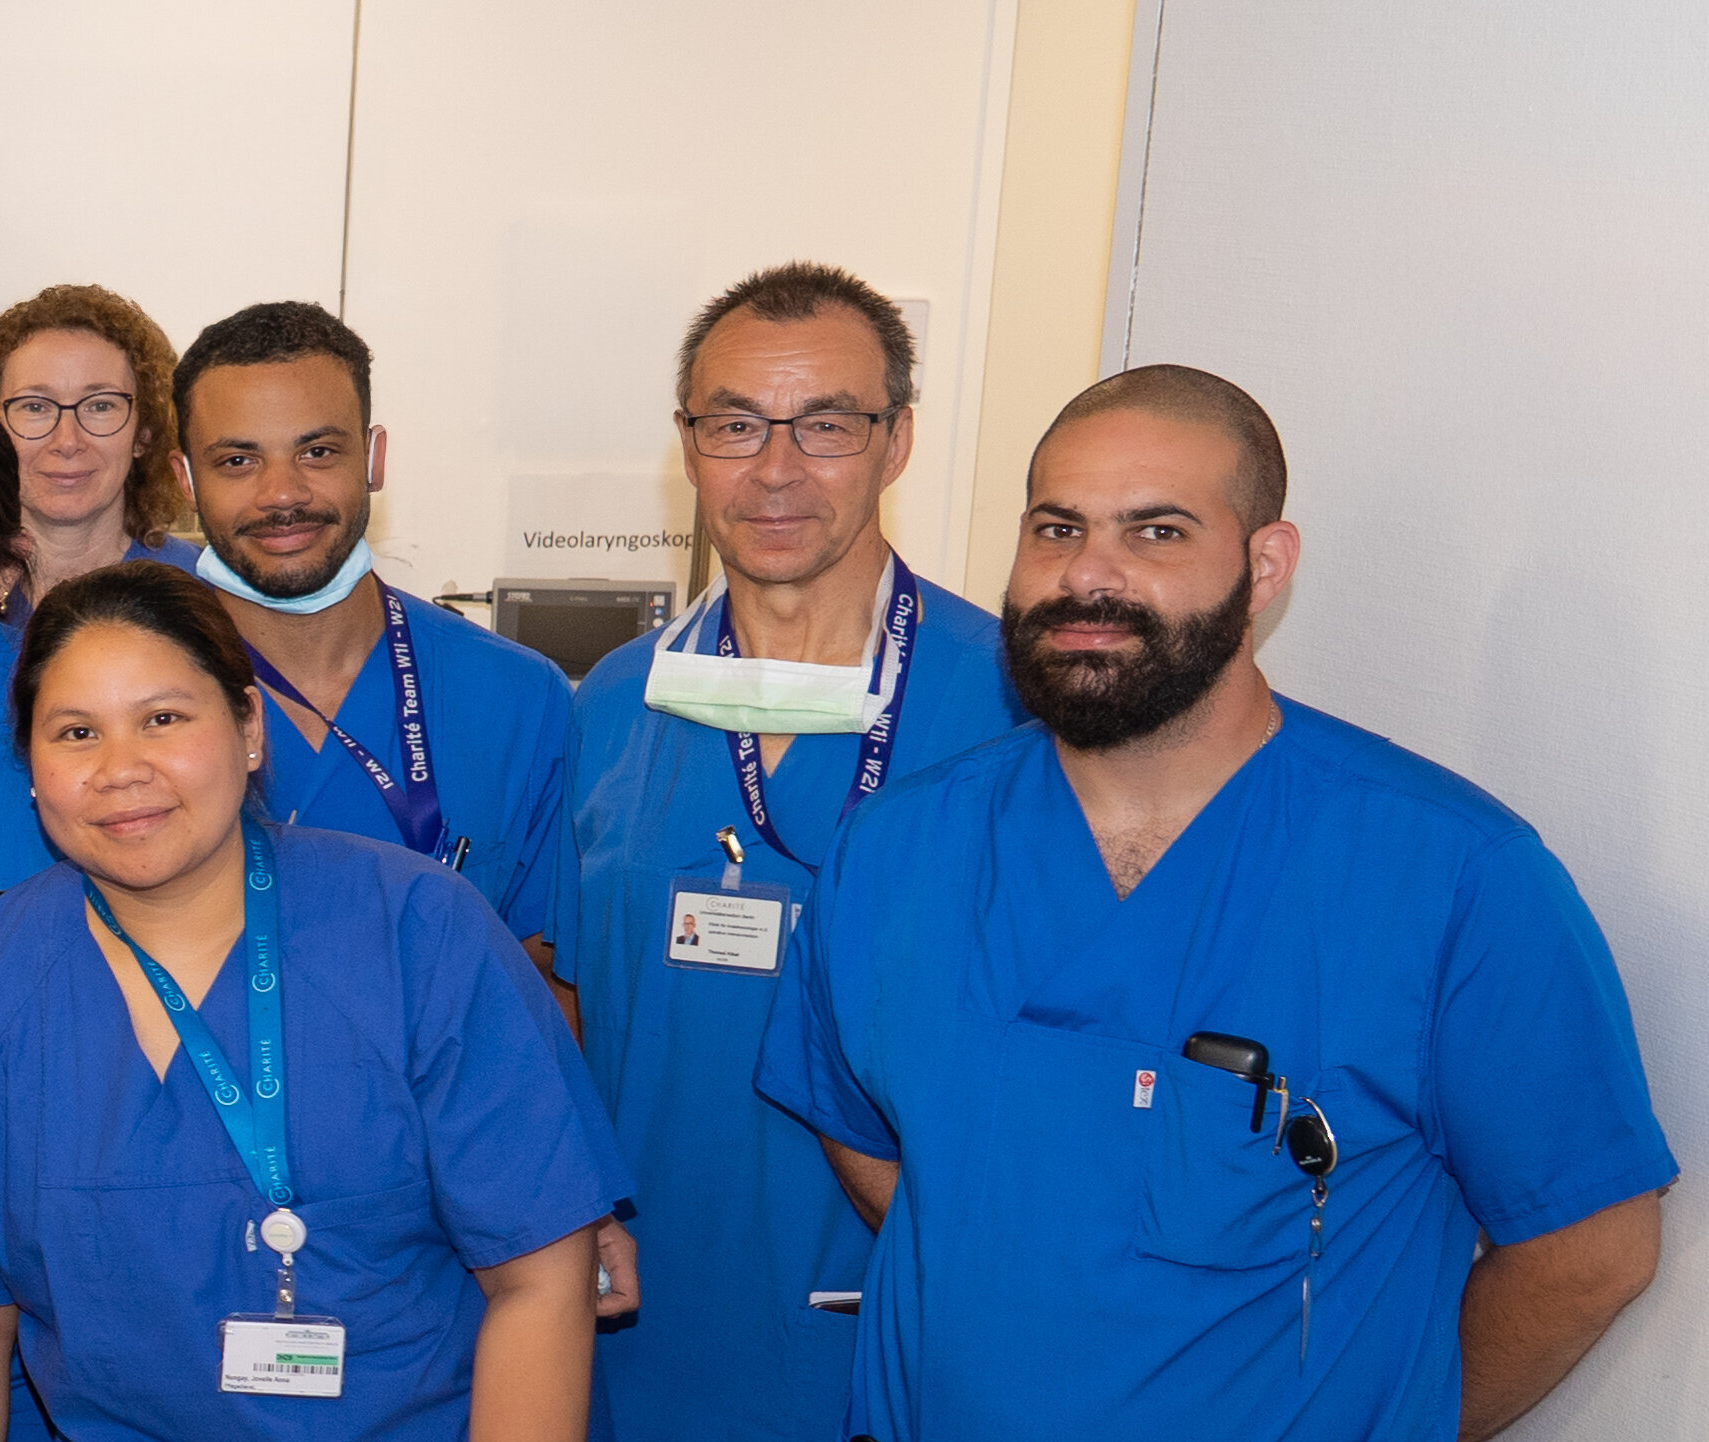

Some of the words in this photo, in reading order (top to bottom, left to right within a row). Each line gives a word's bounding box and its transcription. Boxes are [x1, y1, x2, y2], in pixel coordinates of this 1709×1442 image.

[386, 594, 404, 626] W2i
[393, 642, 412, 668] W1i
[402, 673, 418, 717] Team
[365, 757, 394, 790] W2i
[404, 722, 428, 782] Charité
[859, 757, 883, 794] W2i
[741, 761, 766, 826] Charité
[249, 840, 269, 887] CHARITÉ
[147, 960, 183, 1008] CHARITÉ
[253, 934, 272, 988] CHARITÉ
[198, 1050, 235, 1101] CHARITÉ
[259, 1039, 275, 1095] CHARITÉ
[264, 1145, 288, 1201] CHARITÉ
